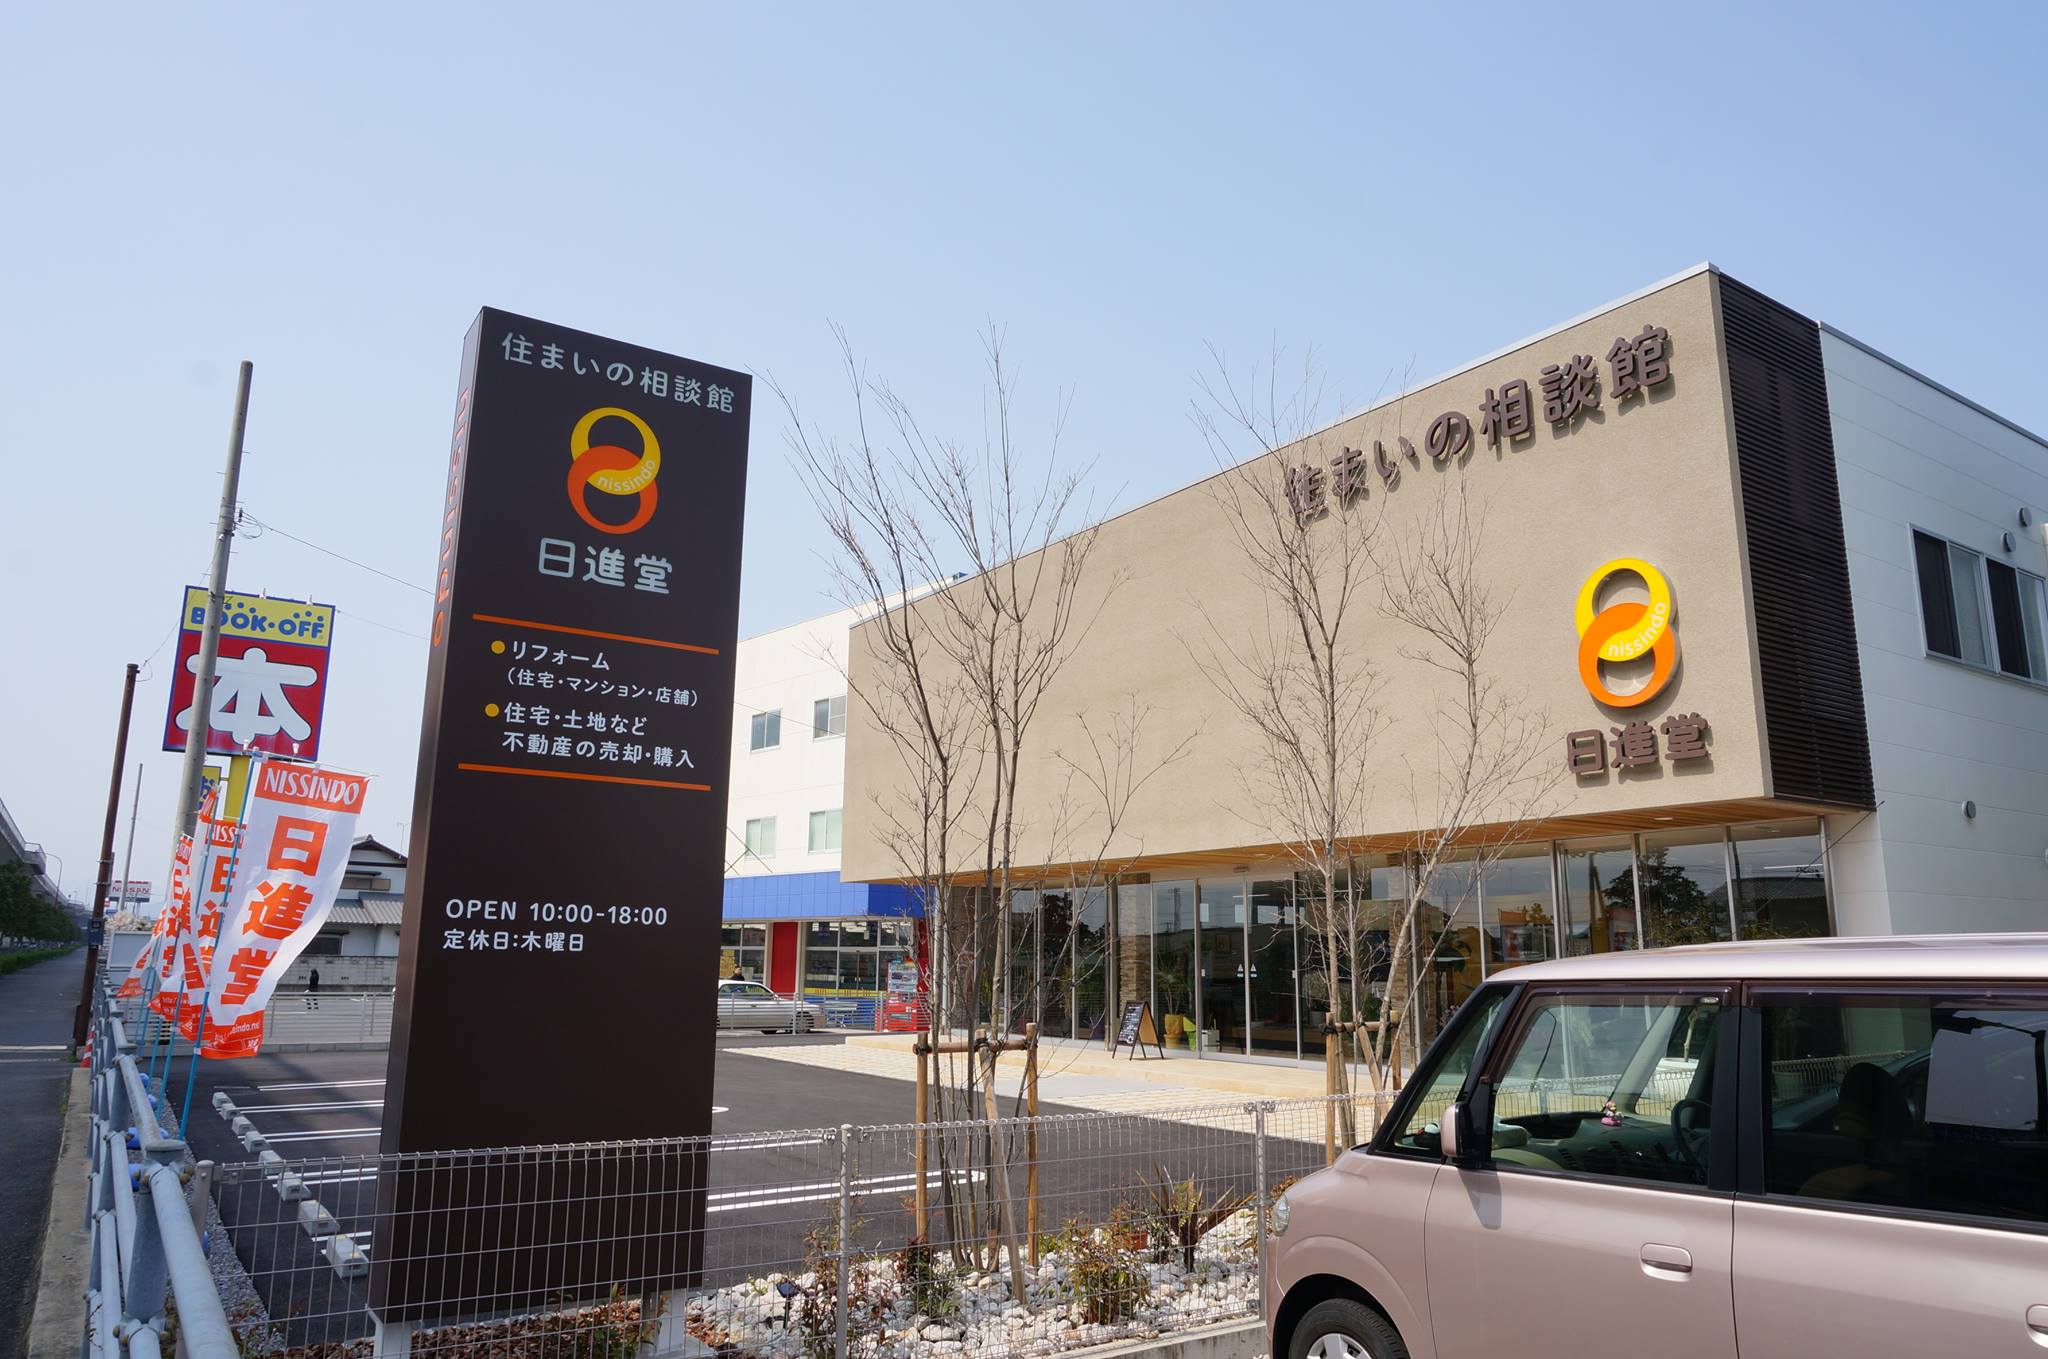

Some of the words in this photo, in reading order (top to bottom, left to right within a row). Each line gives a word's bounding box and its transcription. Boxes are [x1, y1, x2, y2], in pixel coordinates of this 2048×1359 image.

[501, 332, 734, 413] 住まいの相談館
[1284, 324, 1671, 513] 住まいの相談館
[598, 459, 656, 492] nissindo
[433, 387, 468, 647] nissindo
[538, 537, 672, 594] 日進堂
[512, 640, 610, 670] リフォーム
[1608, 601, 1666, 658] nissindo
[175, 647, 318, 745] 本
[503, 702, 648, 736] 住宅・土地など
[501, 731, 695, 769] 不動産の売却・購入
[1566, 712, 1710, 773] 日進堂
[264, 767, 360, 805] NISSINDO
[219, 815, 328, 1005] 日進堂
[445, 898, 517, 921] OPEN
[529, 902, 668, 926] 10:00-18:00
